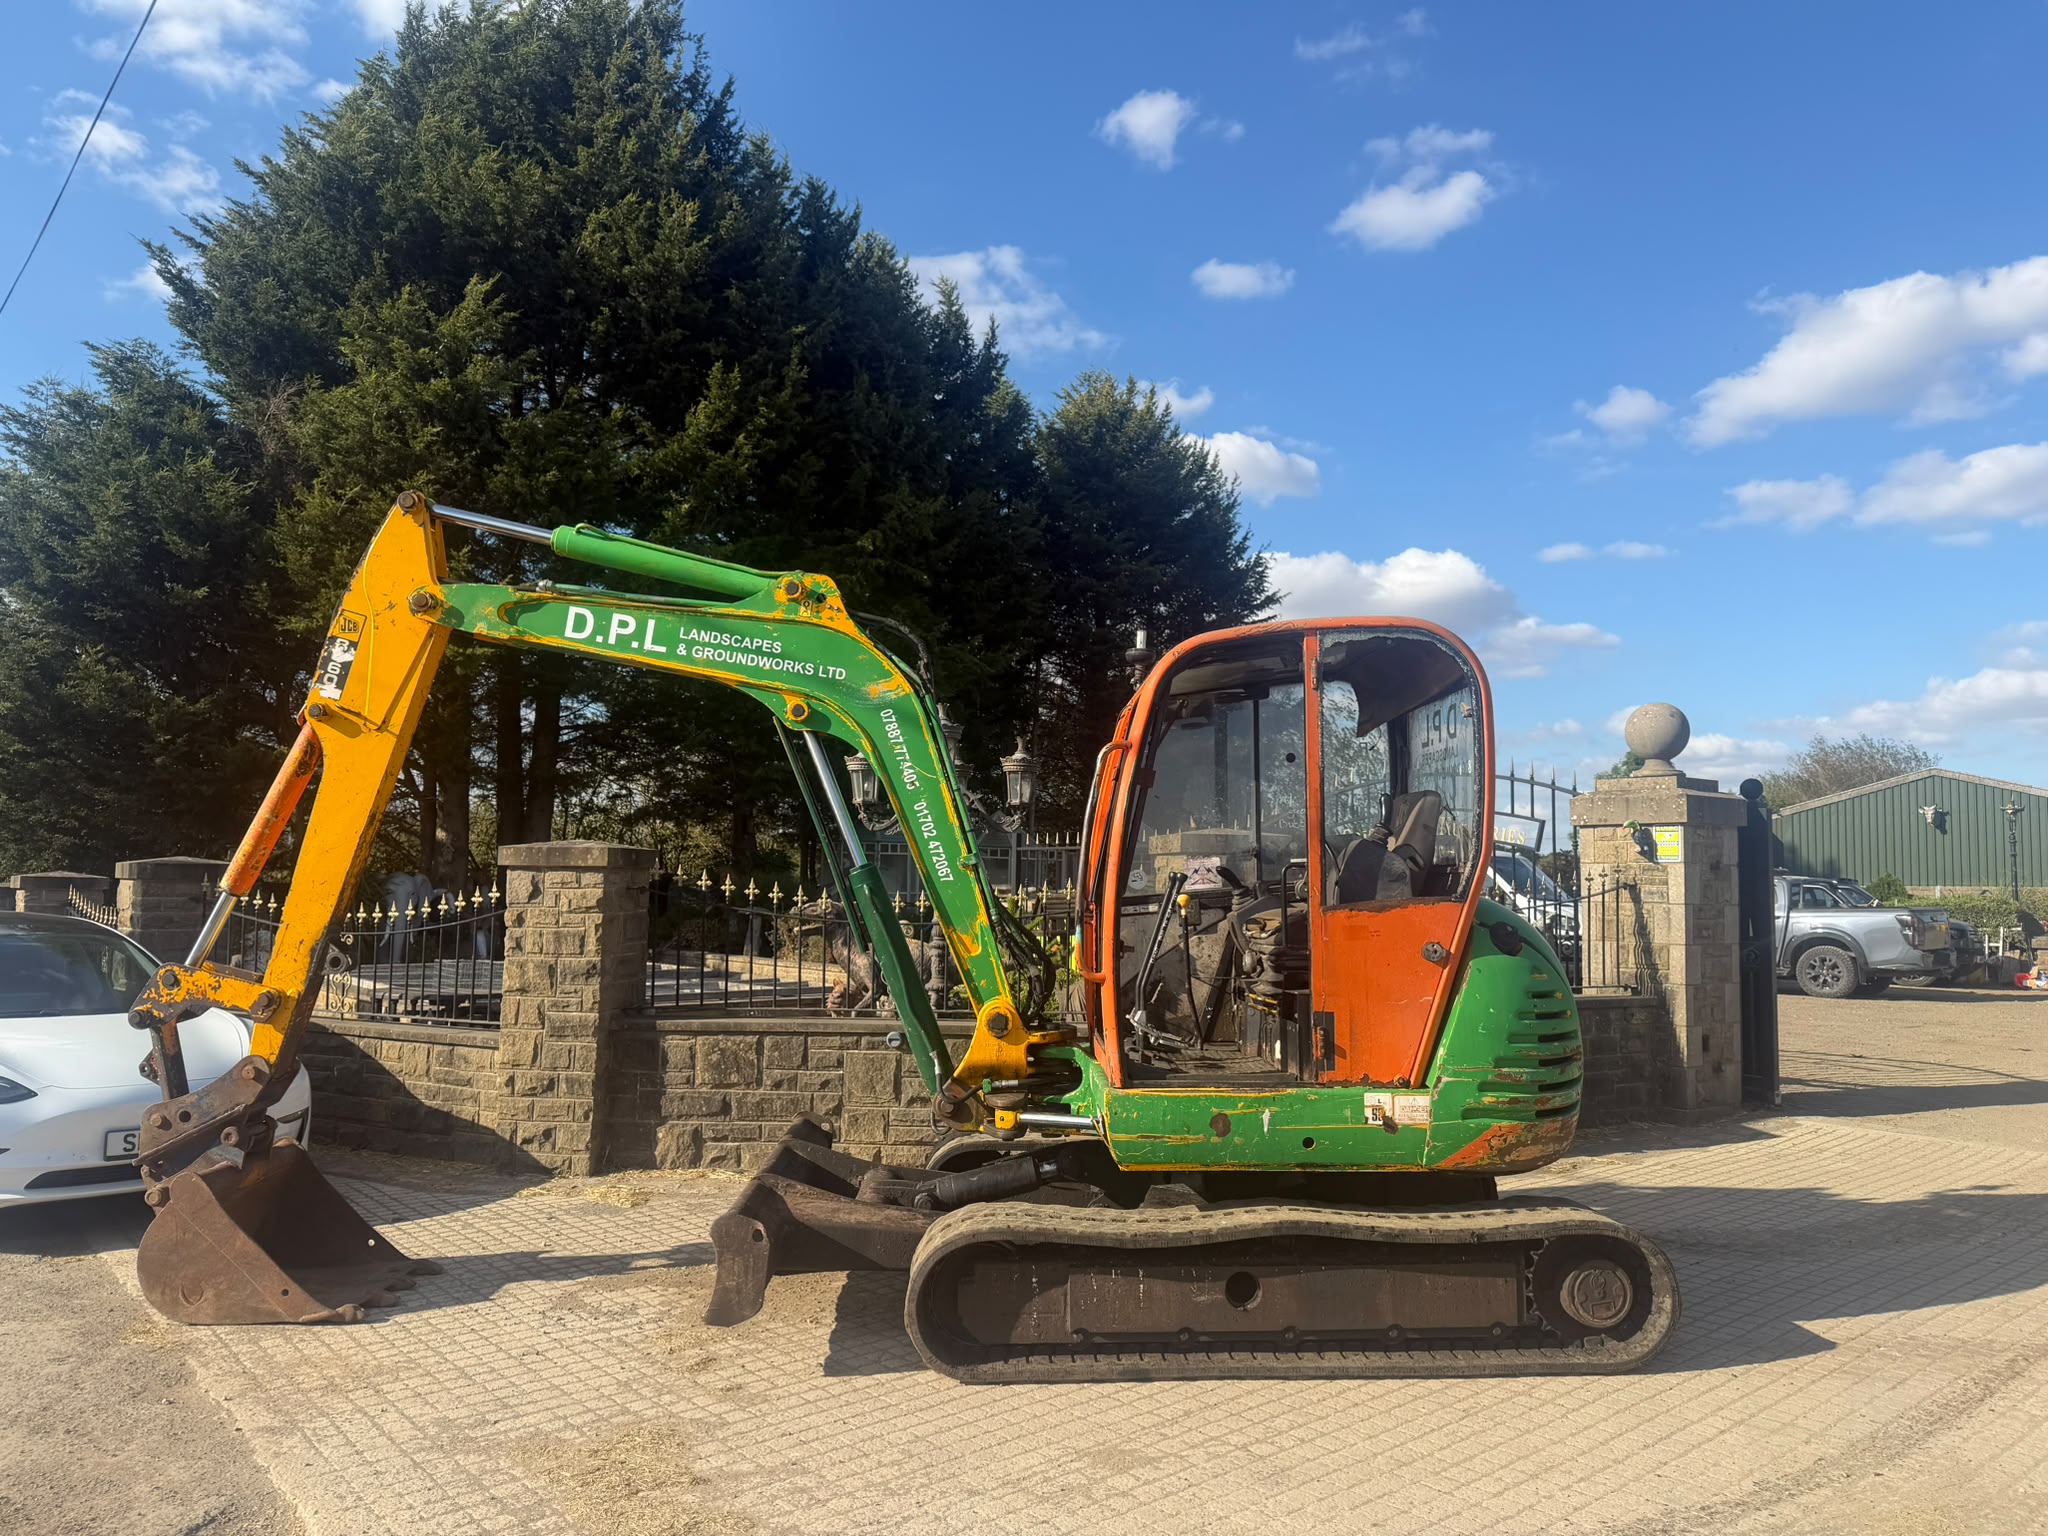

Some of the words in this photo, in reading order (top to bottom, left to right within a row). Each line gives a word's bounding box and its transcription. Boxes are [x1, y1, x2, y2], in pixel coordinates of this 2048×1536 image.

[340, 616, 359, 632] JCB
[564, 606, 667, 653] D.P.L
[679, 627, 782, 653] LANDSCAPES
[676, 643, 687, 656] &
[692, 646, 815, 675] GROUNDWORKS
[818, 666, 846, 680] LTD
[880, 709, 903, 744] 07887
[914, 802, 937, 839] 01702
[928, 842, 954, 882] 472067
